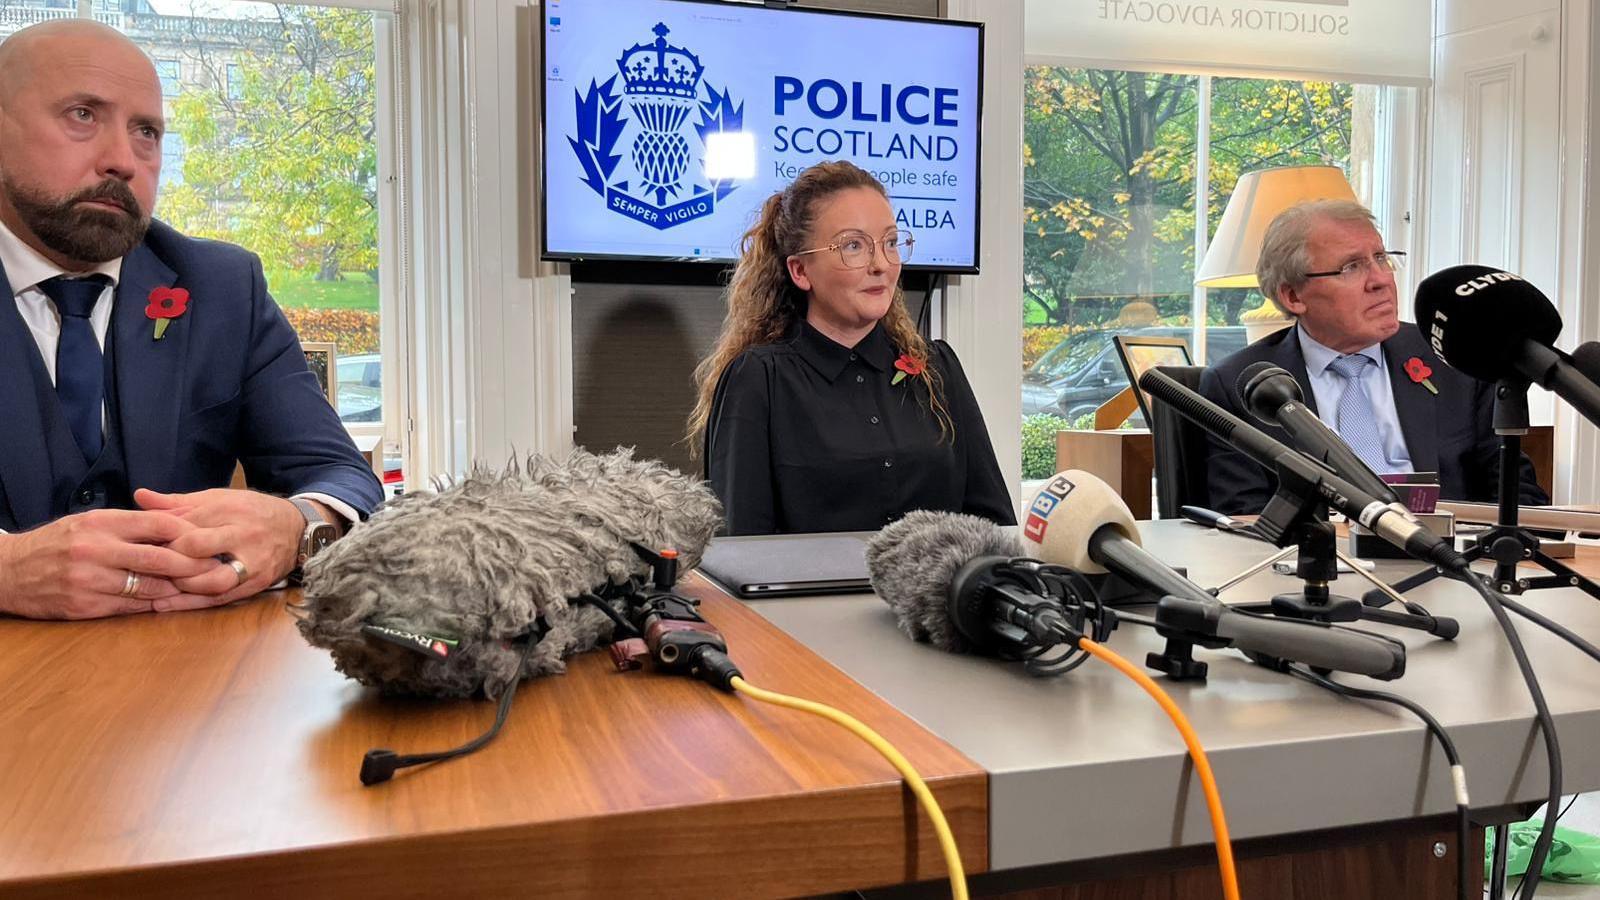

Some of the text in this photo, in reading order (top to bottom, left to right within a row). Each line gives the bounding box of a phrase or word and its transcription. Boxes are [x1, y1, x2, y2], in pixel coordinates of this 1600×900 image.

[774, 75, 959, 127] POLICE
[773, 125, 958, 161] SCOTLAND
[922, 170, 958, 187] safe
[612, 197, 707, 222] SEMPER VIGILO
[896, 208, 956, 229] ALBA
[1435, 310, 1448, 322] 1
[1025, 478, 1073, 541] LBC
